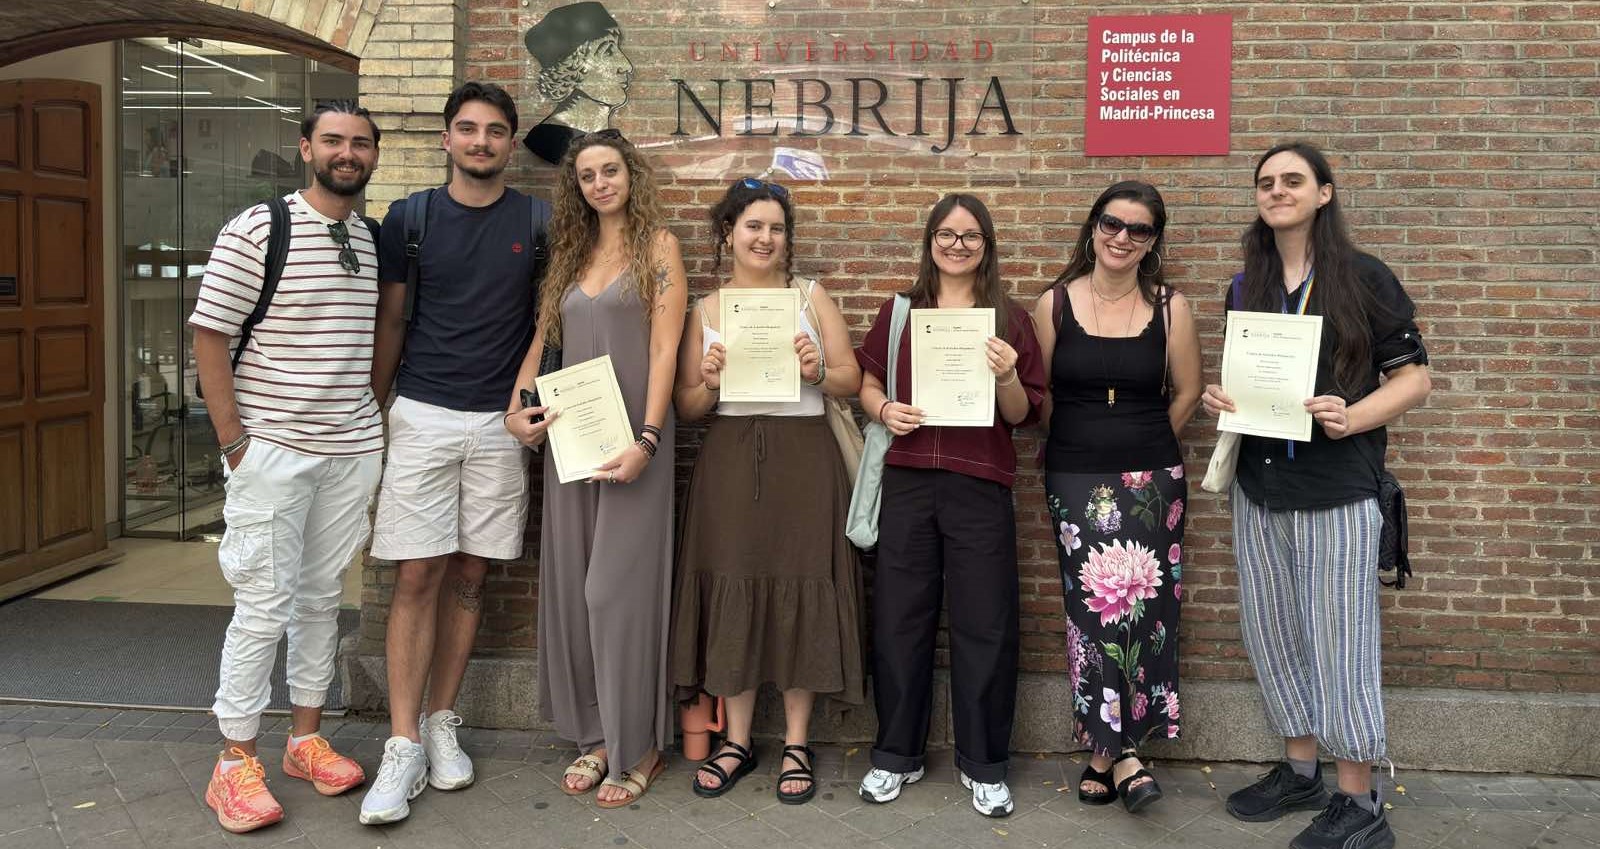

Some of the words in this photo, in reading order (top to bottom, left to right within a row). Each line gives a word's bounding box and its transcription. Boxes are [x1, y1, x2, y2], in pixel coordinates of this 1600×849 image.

[1102, 29, 1156, 46] Campus
[1160, 29, 1177, 43] de
[1181, 29, 1195, 43] la
[689, 40, 994, 62] UNIVERSIDAD
[1101, 48, 1181, 63] Politécnica
[1100, 70, 1108, 85] y
[1112, 68, 1173, 82] Ciencias
[1100, 87, 1159, 101] Sociales
[1163, 89, 1180, 101] en
[670, 76, 1024, 153] NEBRIJA
[1100, 106, 1215, 121] Madrid-Princesa
